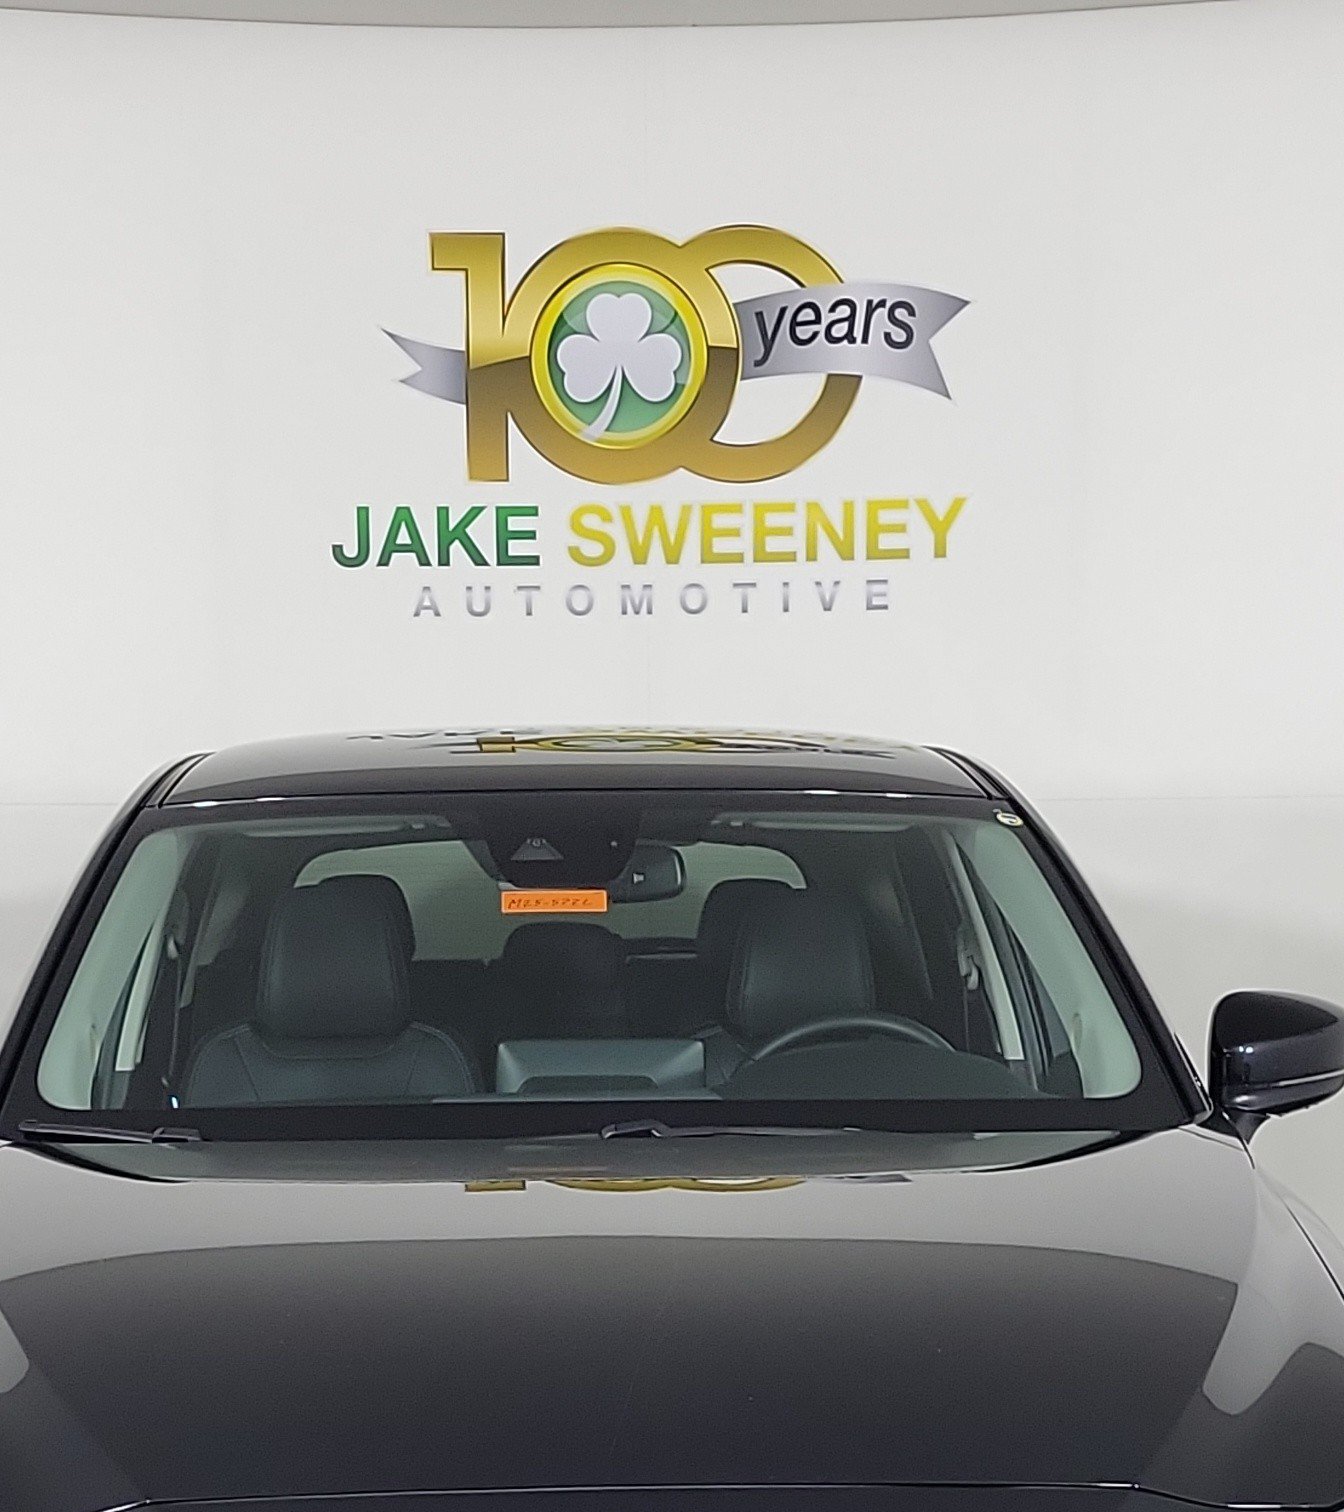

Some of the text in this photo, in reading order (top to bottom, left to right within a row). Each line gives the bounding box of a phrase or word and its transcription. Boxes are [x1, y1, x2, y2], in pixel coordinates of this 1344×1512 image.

[429, 224, 916, 485] 100 years
[331, 497, 967, 569] JAKE SWEENEY
[412, 578, 890, 618] AUTOMOTIVE
